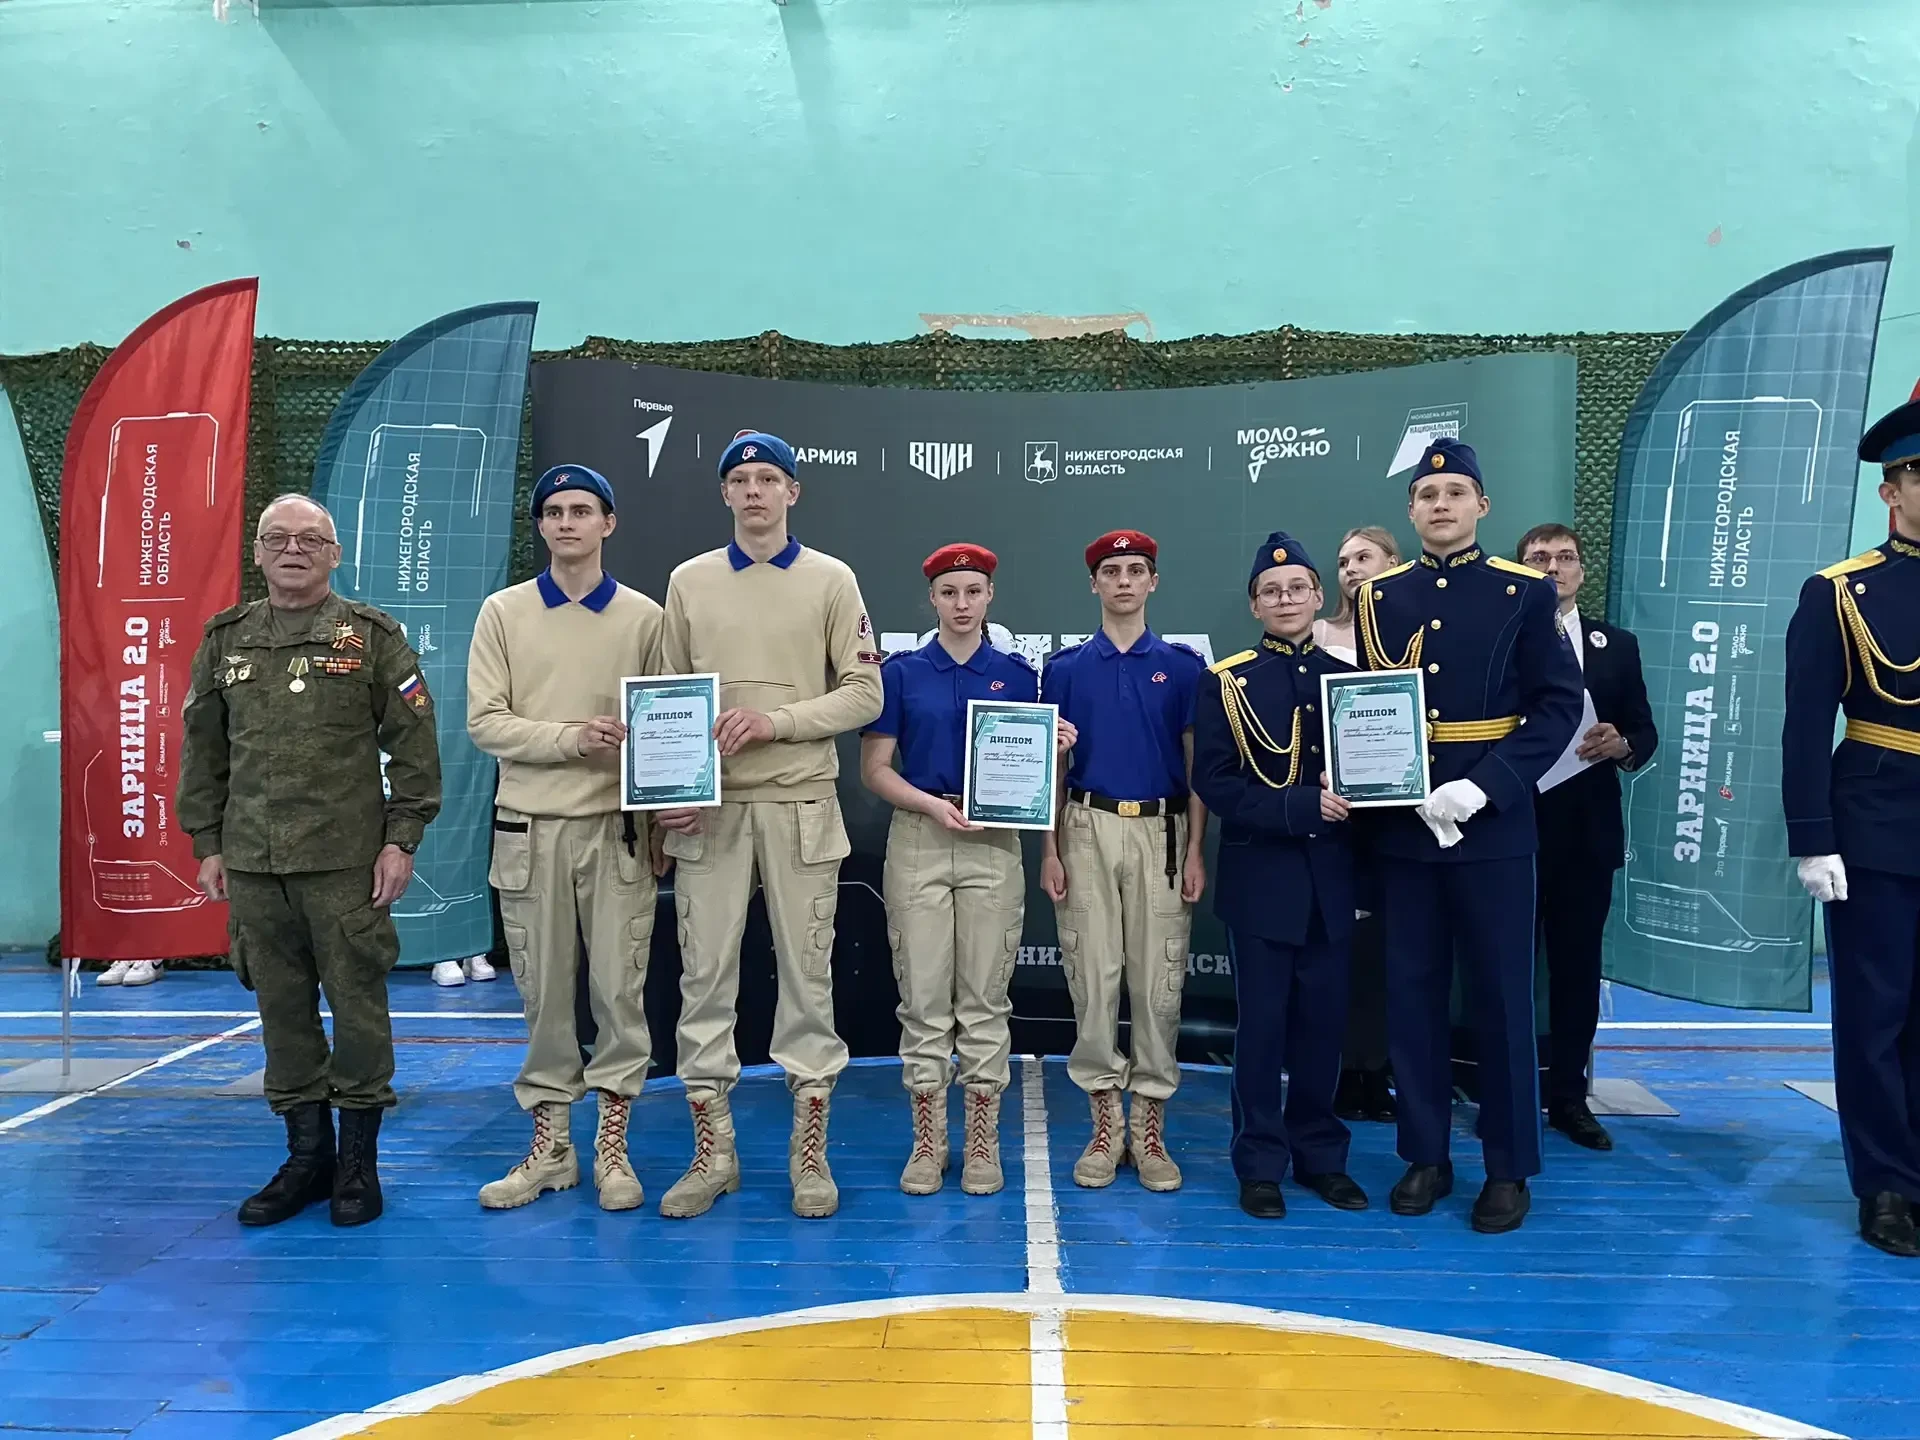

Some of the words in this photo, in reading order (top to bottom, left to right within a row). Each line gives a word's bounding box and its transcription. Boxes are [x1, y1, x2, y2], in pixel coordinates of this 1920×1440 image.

[633, 398, 673, 412] Первые
[1409, 421, 1458, 434] НАЦИОНАЛЬНЫЕ
[790, 446, 857, 466] АРМИЯ
[909, 441, 973, 481] ВОИН
[1064, 464, 1126, 475] ОБЛАСТЬ
[1065, 448, 1184, 461] НИЖЕГОРОДСКАЯ
[139, 443, 158, 586] НИЖЕГОРОДСКАЯ
[398, 452, 421, 592] НИЖЕГОРОДСКАЯ
[1709, 430, 1740, 587] НИЖЕГОРОДСКАЯ
[157, 511, 171, 585] ОБЛАСТЬ
[416, 519, 433, 592] ОБЛАСТЬ
[1731, 506, 1754, 588] ОБЛАСТЬ
[122, 616, 149, 665] 2.0
[1688, 620, 1720, 675] 2.0
[647, 711, 693, 722] ДИПЛОМ
[1349, 708, 1397, 719] ДИПЛОМ
[119, 675, 150, 839] ЗАРНИЦА
[990, 735, 1033, 745] ДИПЛОМ
[1674, 685, 1718, 863] ЗАРНИЦА
[160, 831, 168, 846] Это
[1715, 861, 1724, 877] Это
